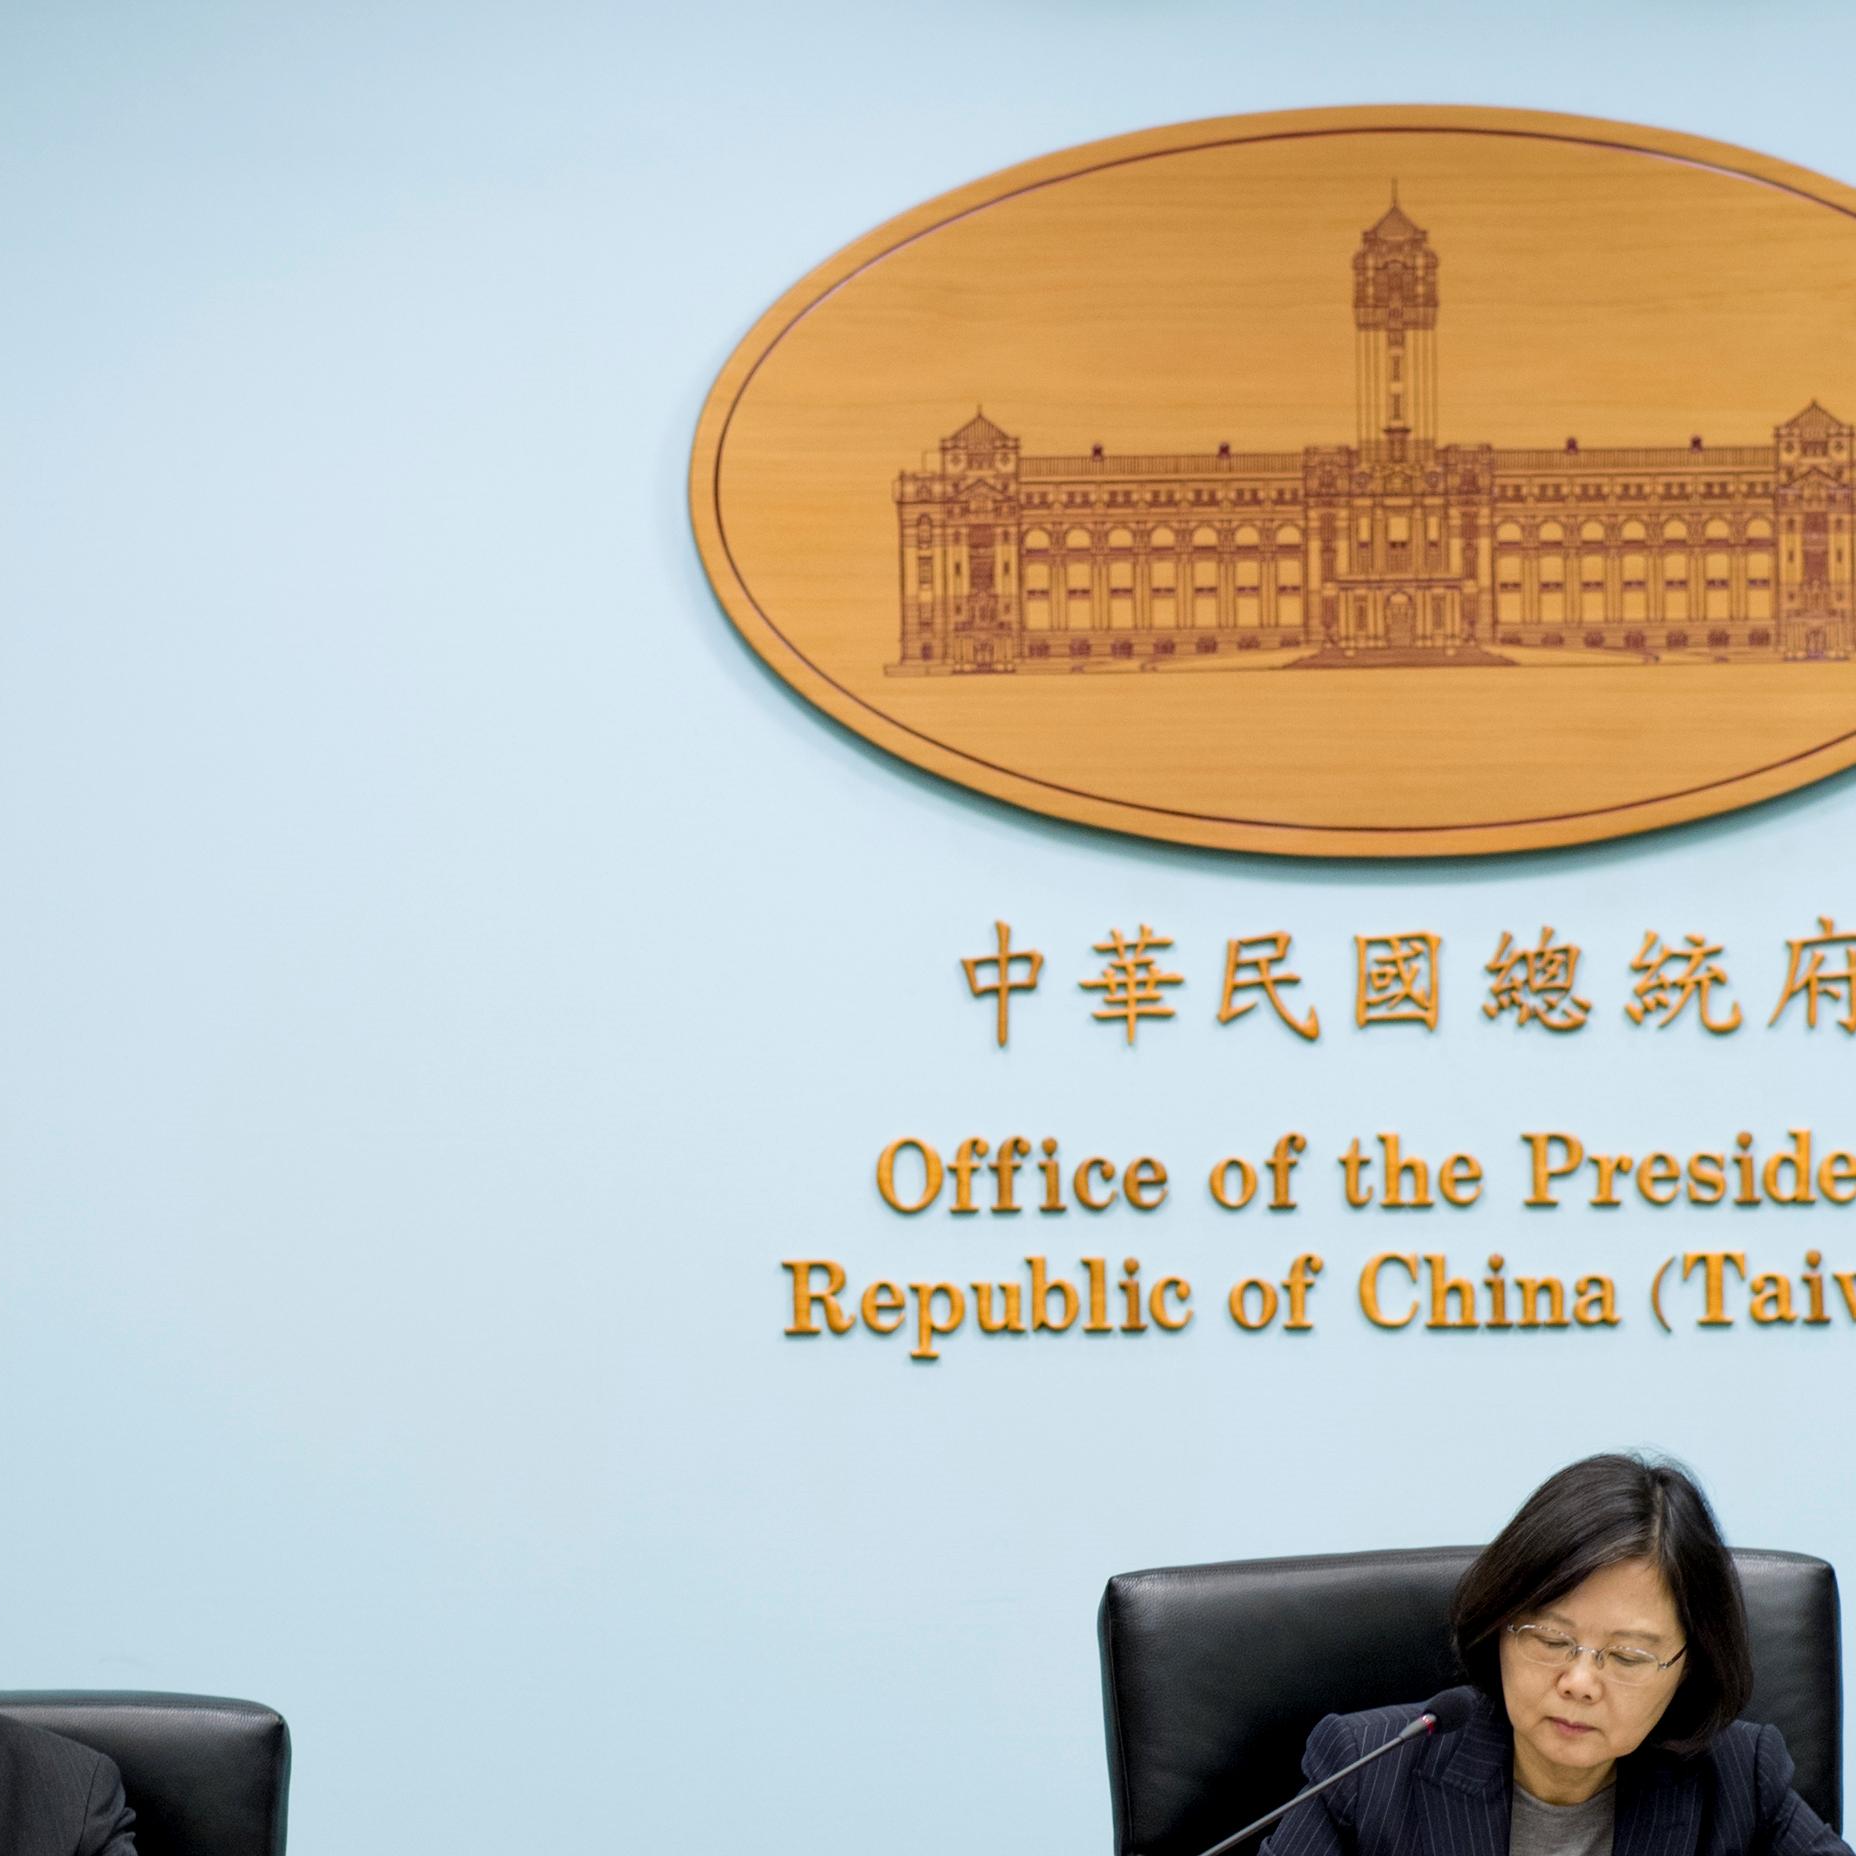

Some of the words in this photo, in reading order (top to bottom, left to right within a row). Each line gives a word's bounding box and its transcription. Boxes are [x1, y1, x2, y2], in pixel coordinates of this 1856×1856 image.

[876, 1136, 1169, 1214] Office
[1209, 1132, 1308, 1210] of
[1339, 1131, 1484, 1209] the
[782, 1255, 1194, 1360] Republic
[1228, 1252, 1325, 1330] of
[1358, 1251, 1621, 1330] China
